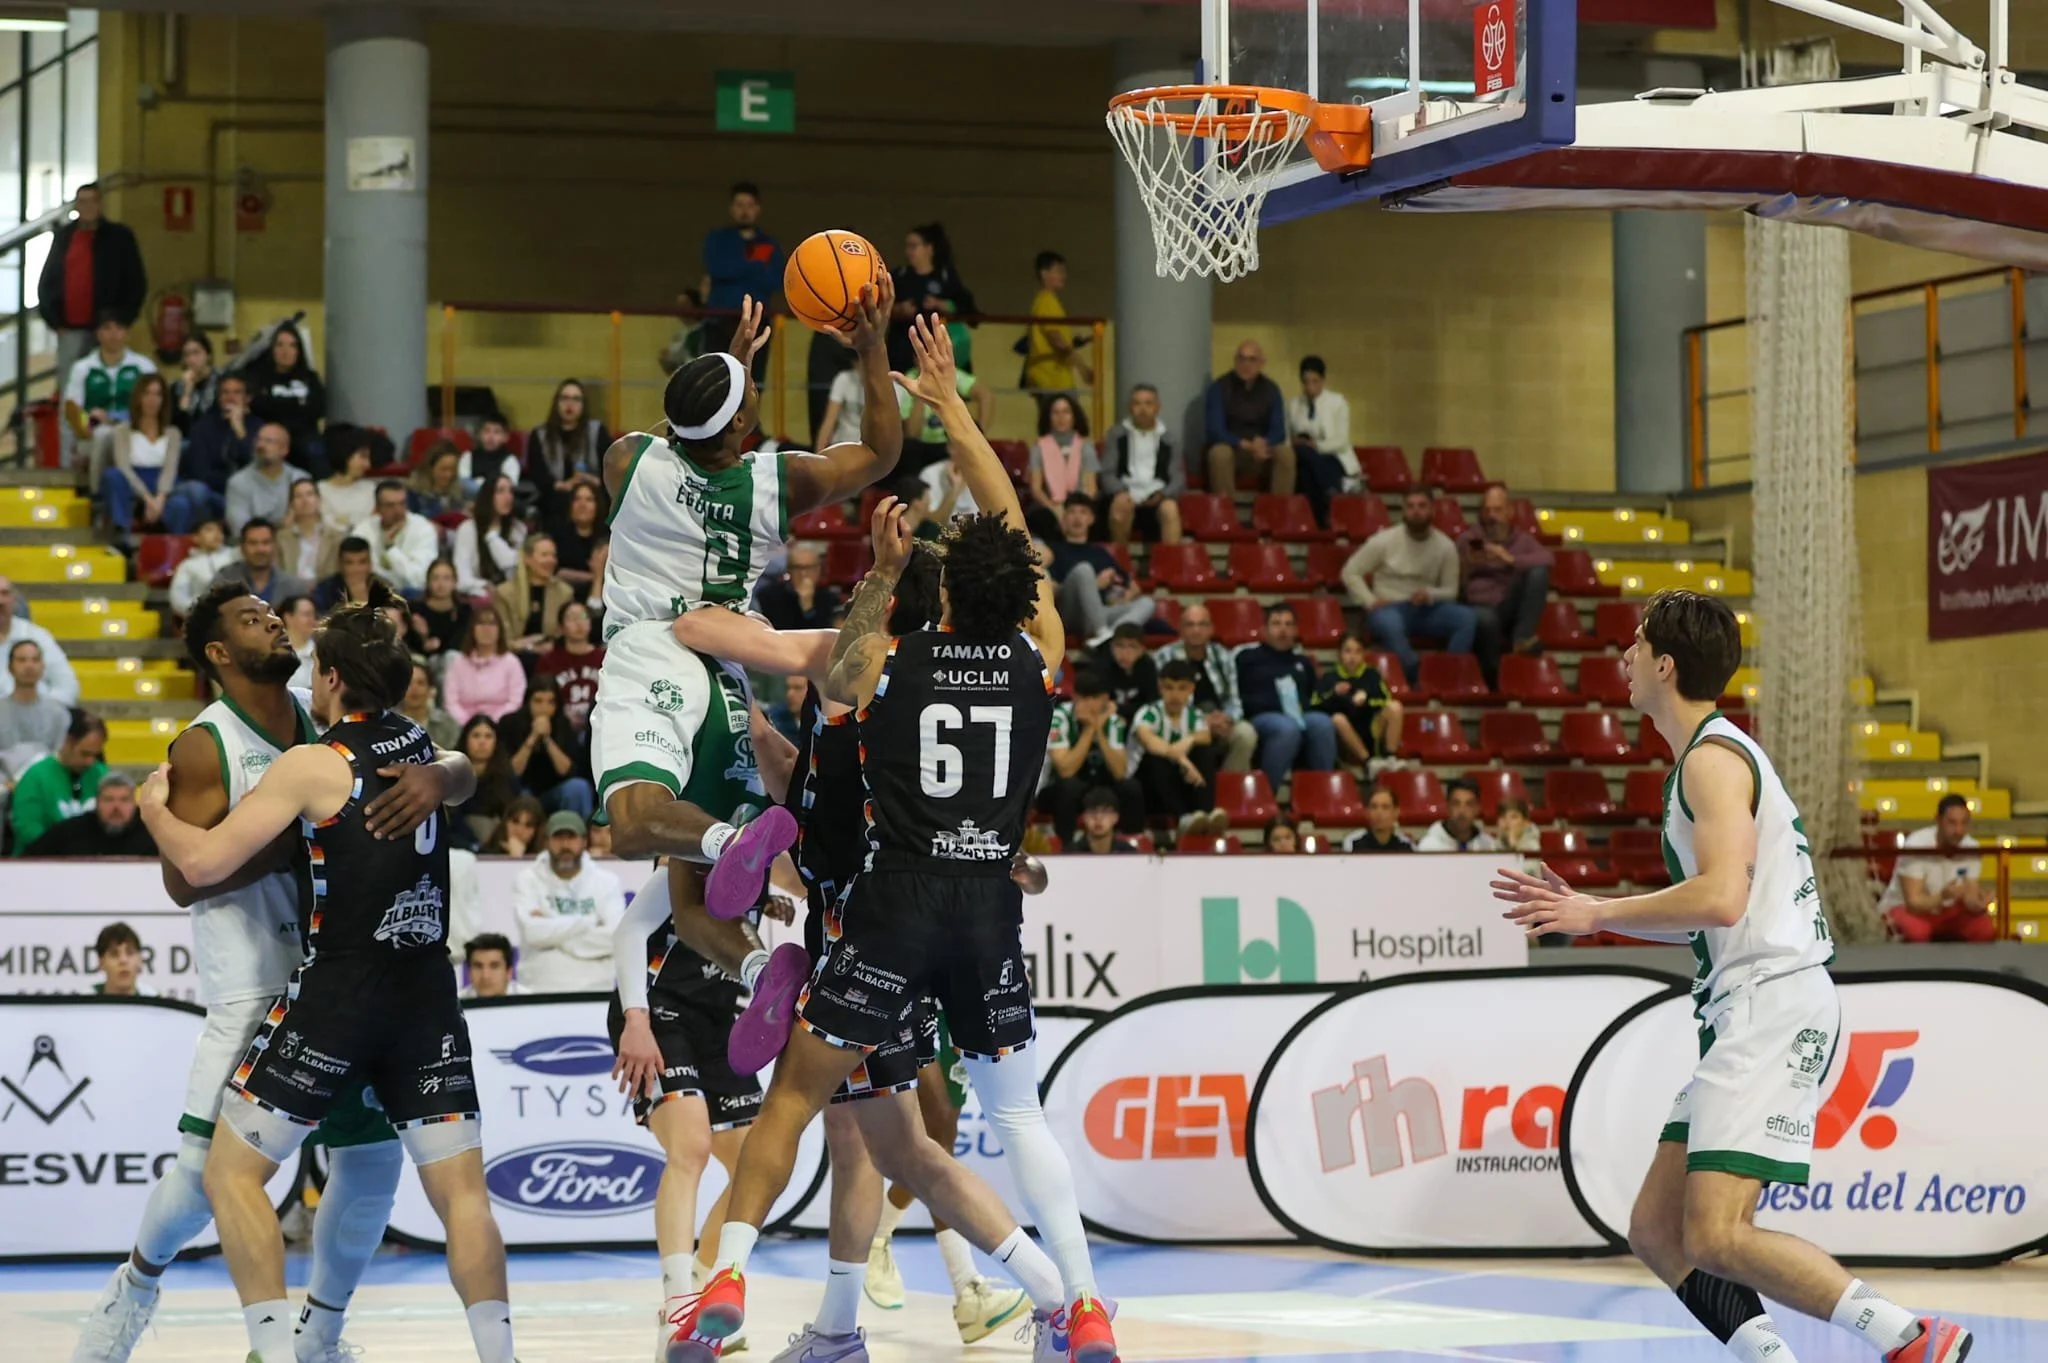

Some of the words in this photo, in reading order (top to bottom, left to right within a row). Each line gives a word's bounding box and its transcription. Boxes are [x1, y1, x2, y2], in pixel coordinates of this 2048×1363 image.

[741, 81, 770, 122] E
[705, 525, 740, 585] 2
[932, 644, 1012, 660] TAMAYO
[948, 670, 1009, 685] UCLM
[919, 702, 1013, 799] 67
[1352, 926, 1483, 964] Hospital
[852, 970, 904, 995] ALBACETE
[857, 960, 908, 985] Ayuntamiento
[298, 1054, 348, 1076] ALBACETE
[519, 1153, 646, 1204] Ford
[1846, 1170, 1907, 1211] del
[1914, 1174, 2026, 1214] Acero
[1855, 1307, 1876, 1331] CCB
